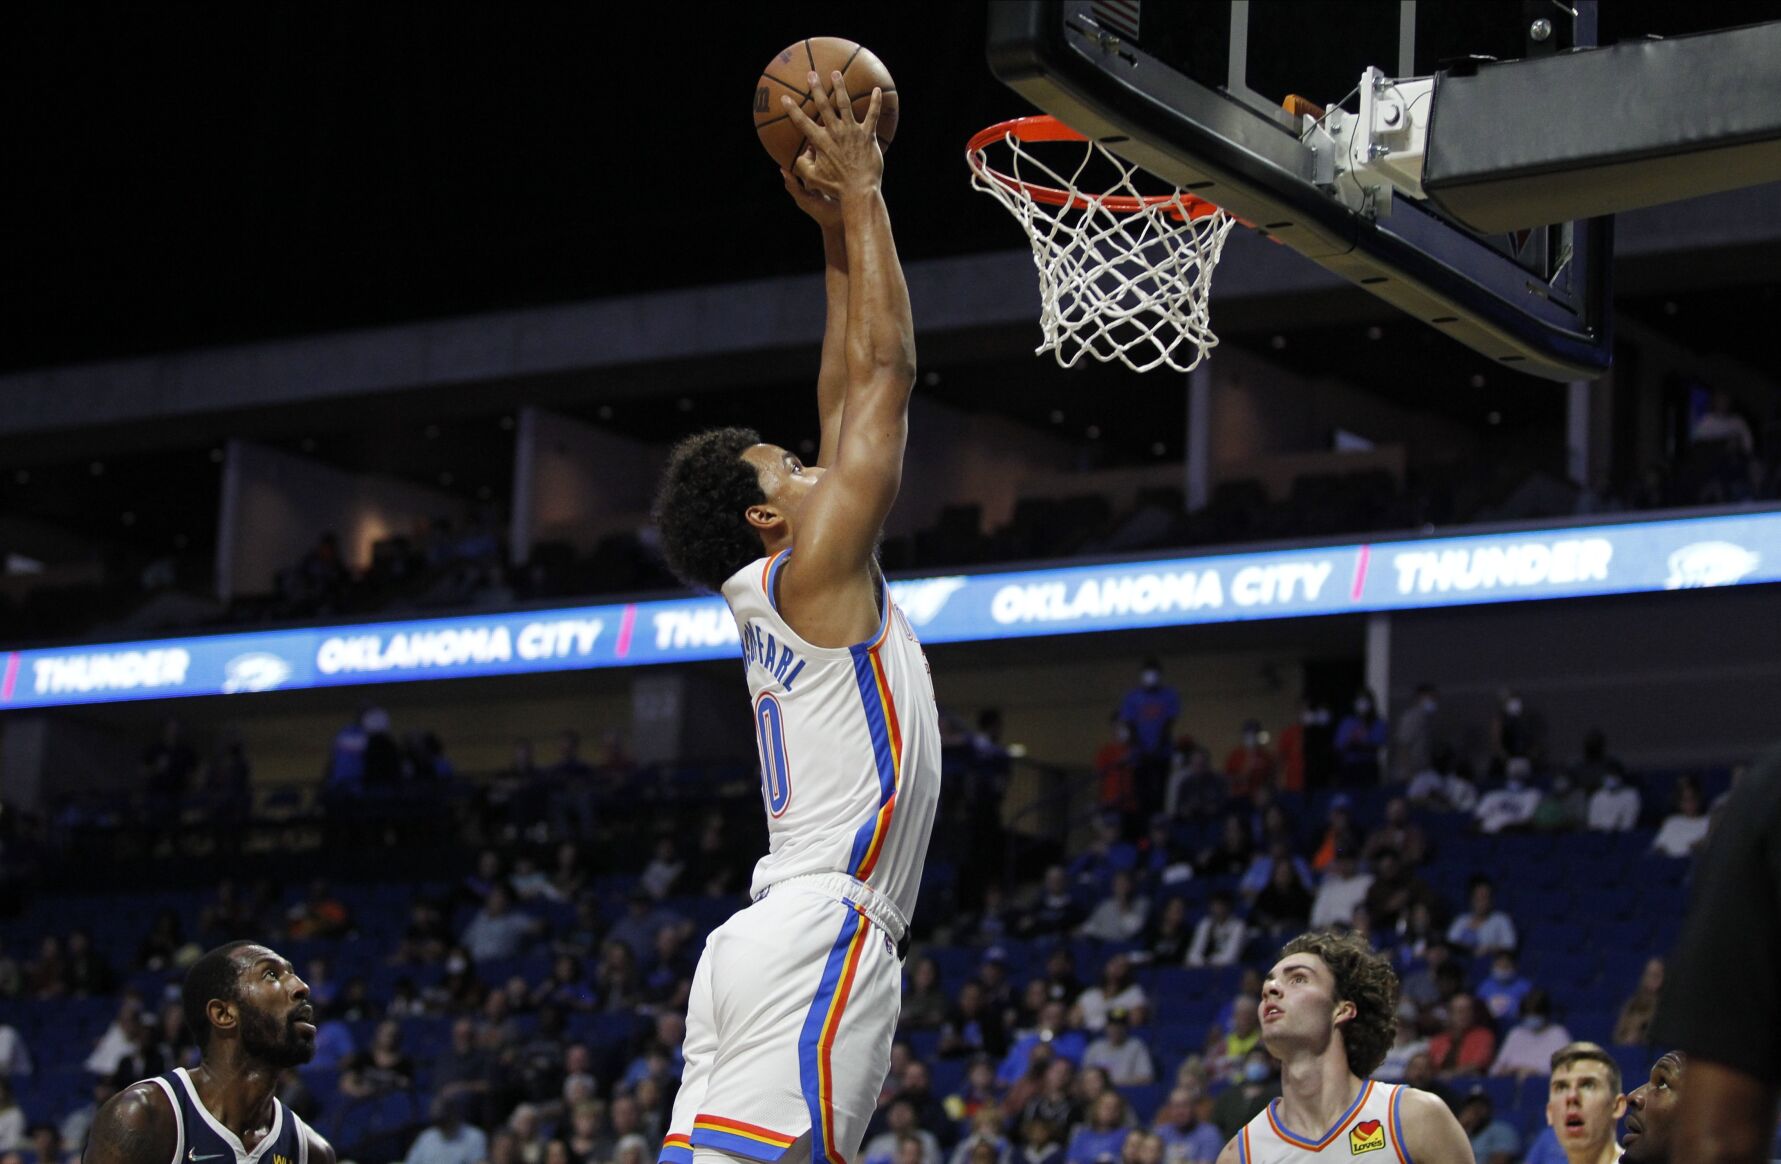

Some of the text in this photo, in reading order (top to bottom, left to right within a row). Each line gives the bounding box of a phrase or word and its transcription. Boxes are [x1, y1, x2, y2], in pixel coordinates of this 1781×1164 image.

[991, 561, 1333, 624] OKLAHOMA CITY
[1394, 538, 1613, 594] THUNDER
[33, 647, 190, 694] THUNDER
[317, 618, 603, 675] OKLAHOMA CITY
